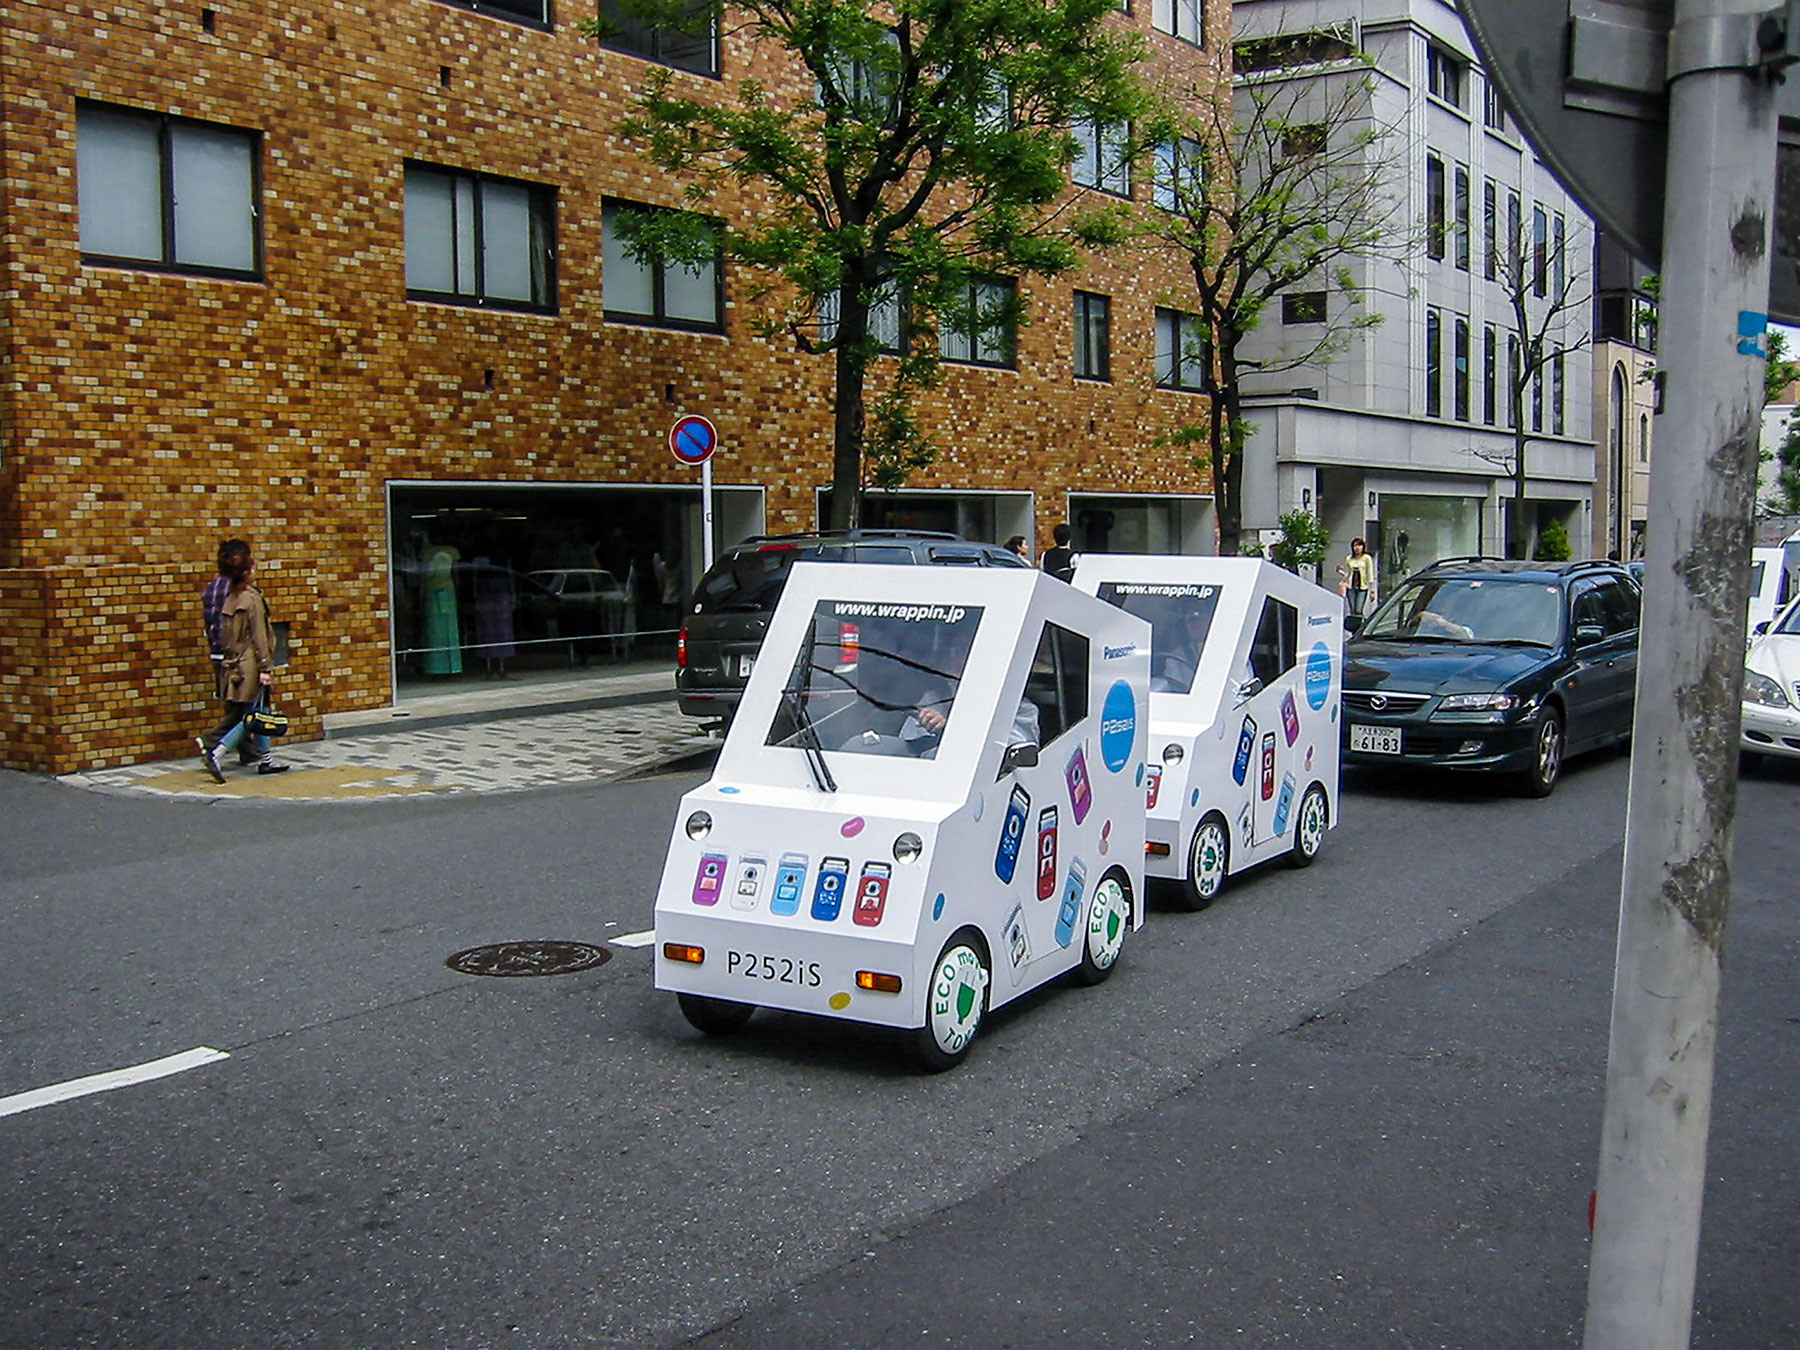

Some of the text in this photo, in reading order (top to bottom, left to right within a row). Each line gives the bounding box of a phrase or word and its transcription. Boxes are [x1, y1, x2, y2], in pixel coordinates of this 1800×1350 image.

[1116, 585, 1213, 598] www.wrappin.jp
[834, 602, 966, 623] www.wrappin.jp
[1361, 736, 1399, 752] 61-83
[1091, 891, 1108, 934] ECO
[728, 951, 821, 987] P252iS
[935, 963, 956, 1015] ECO
